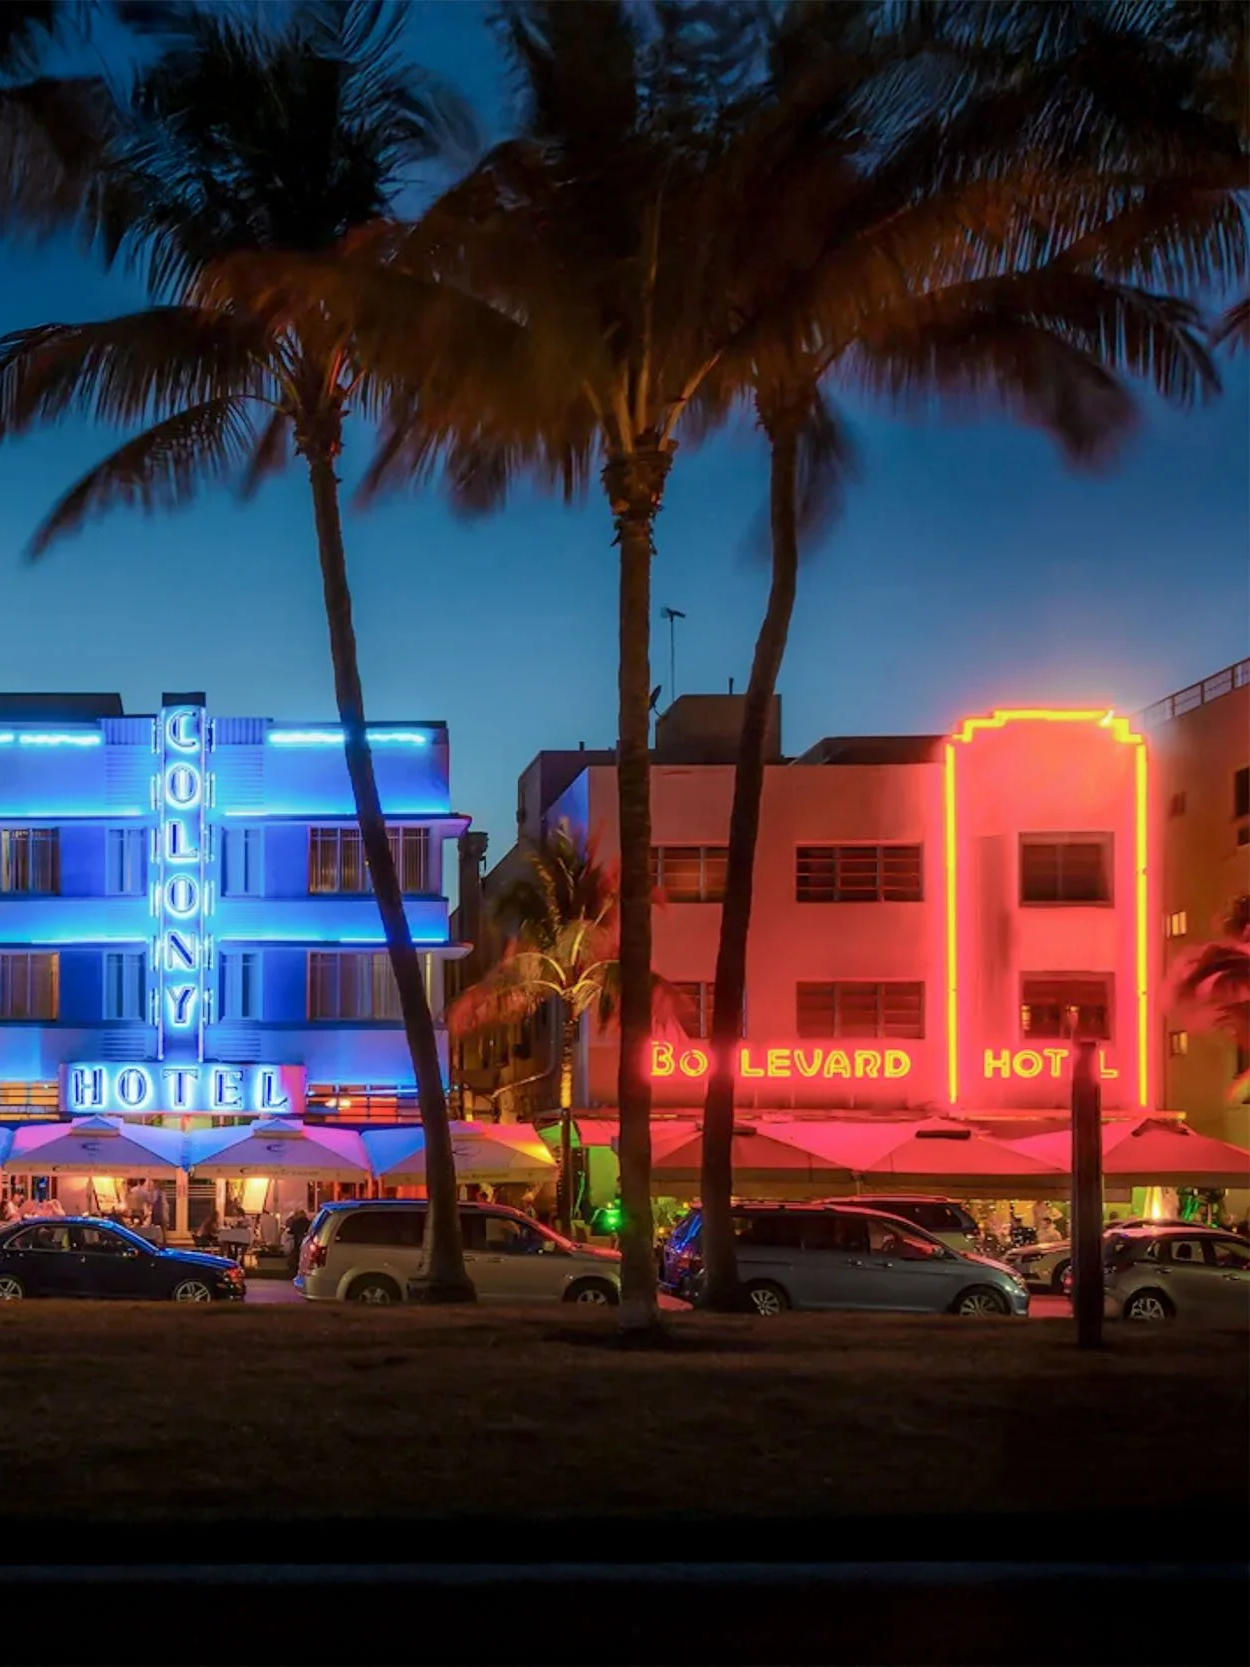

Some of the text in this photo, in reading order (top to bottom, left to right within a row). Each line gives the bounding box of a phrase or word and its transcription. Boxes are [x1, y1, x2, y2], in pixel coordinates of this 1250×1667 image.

[166, 710, 199, 1025] COLONY
[650, 1041, 1119, 1079] BOLEVARD HOTL
[72, 1067, 289, 1109] HOTEL
